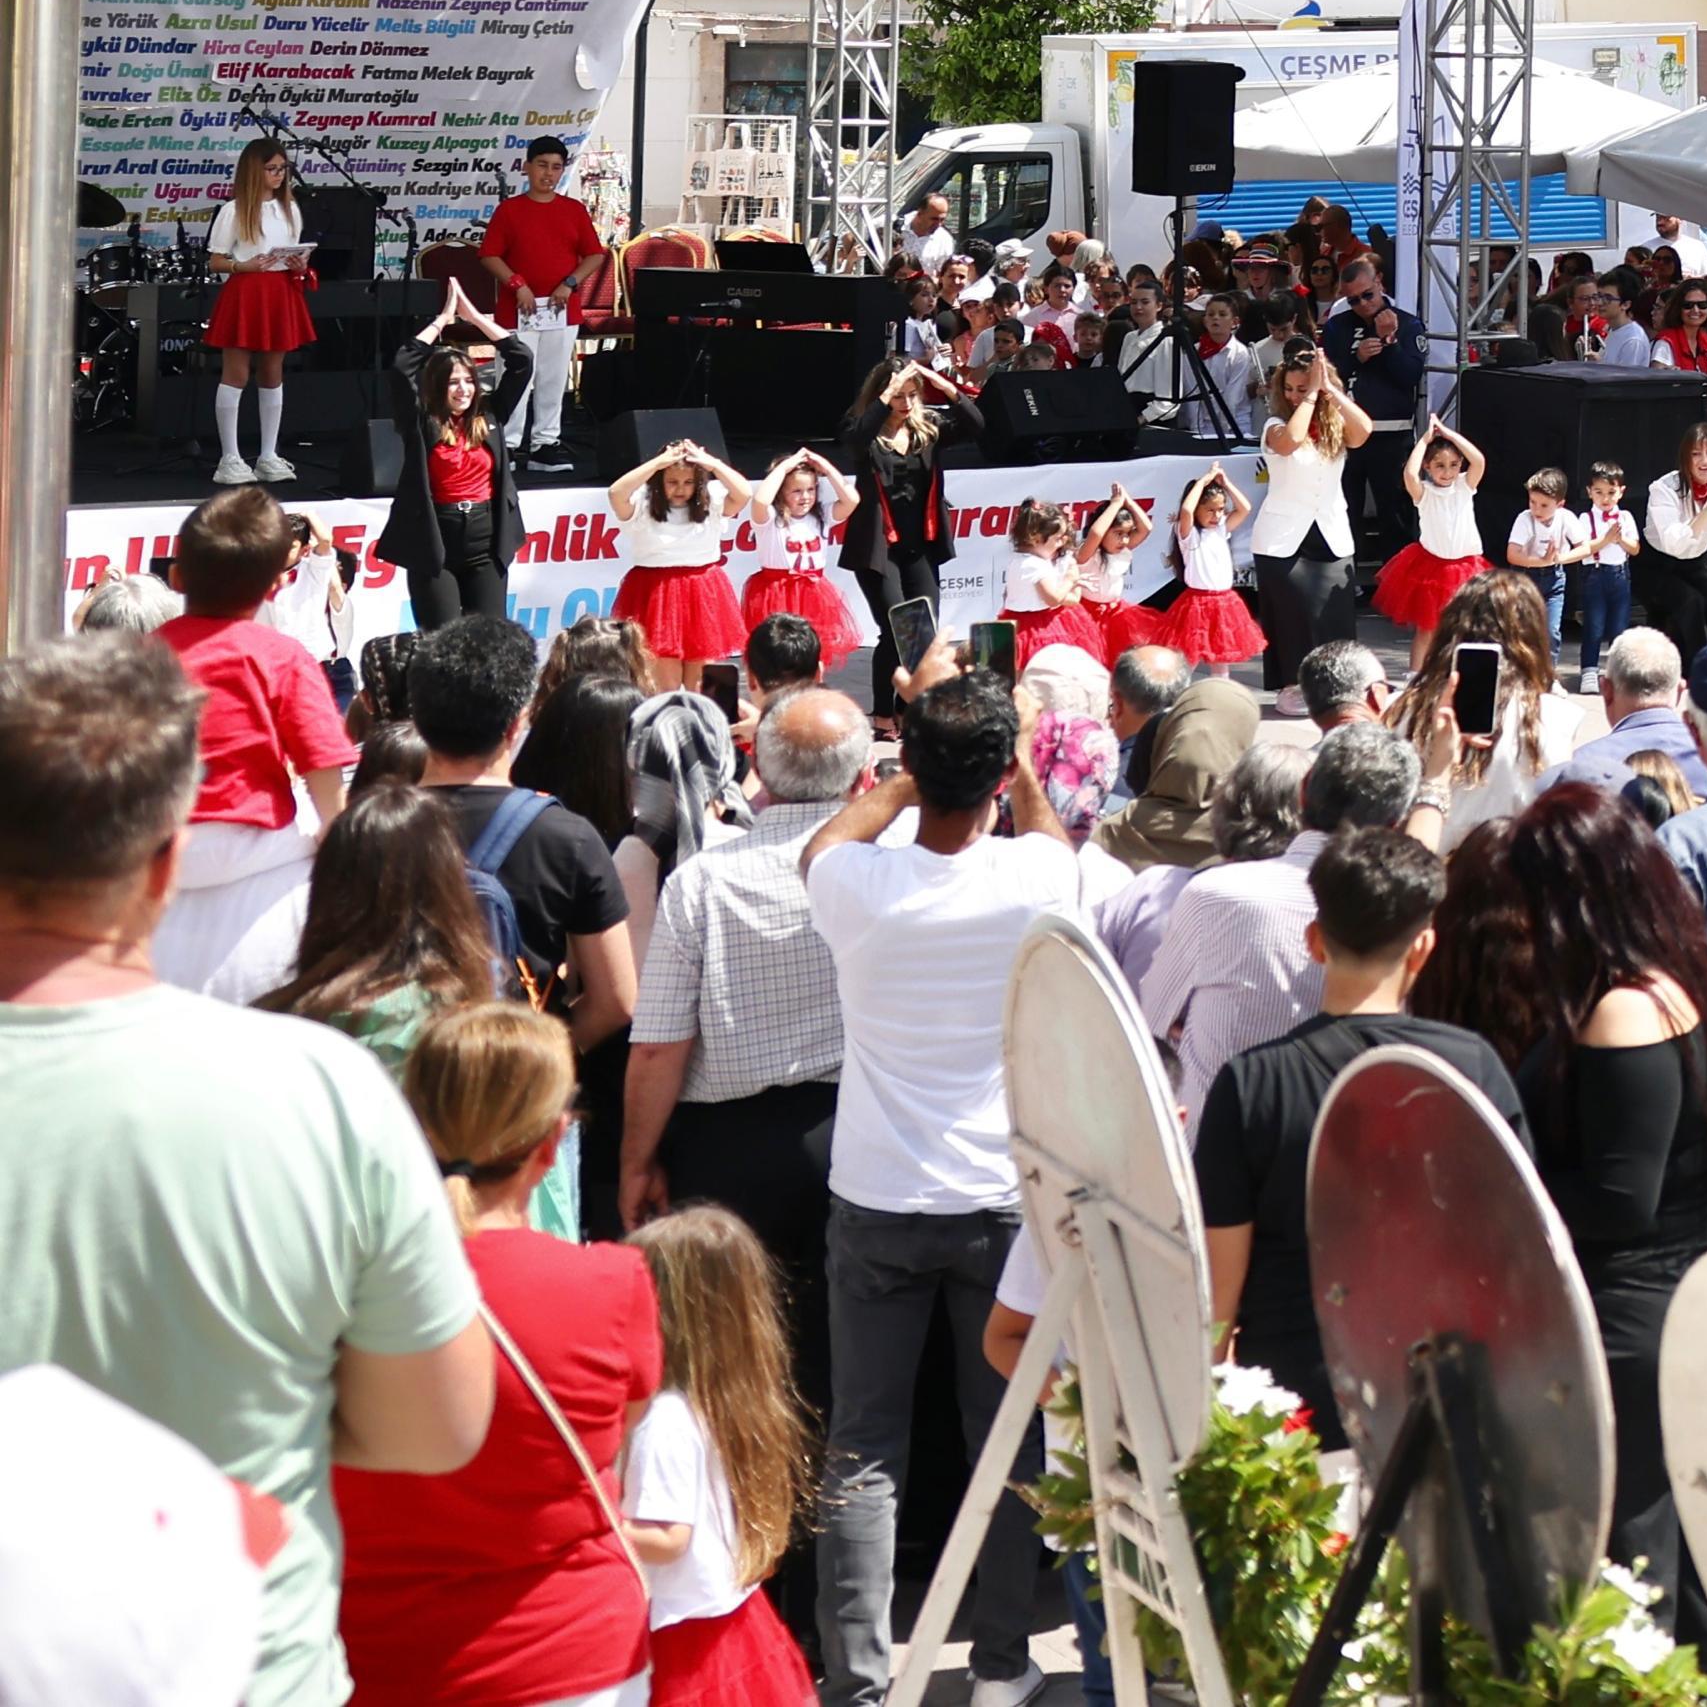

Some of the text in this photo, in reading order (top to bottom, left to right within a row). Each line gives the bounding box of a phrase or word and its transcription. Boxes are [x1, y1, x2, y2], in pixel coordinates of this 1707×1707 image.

[106, 12, 573, 39] Yörük Azra Usul Duru Yücelir Melis Bilgili Miray Çetin
[125, 37, 429, 59] Dündar Hira Ceylan Derin Dönmez
[117, 60, 165, 83] Doğa
[217, 62, 250, 83] Elif
[253, 61, 354, 80] Karabacak
[362, 65, 418, 80] Fatma
[421, 66, 473, 80] Melek
[476, 66, 534, 85] Bayrak
[1280, 53, 1367, 80] ÇEŞME
[157, 86, 196, 104] Eliz
[196, 82, 221, 102] Öz
[279, 83, 324, 107] Öykü
[327, 89, 418, 107] Muratoğlu
[122, 109, 574, 132] Erten Öykü Zeynep Kumral Nehir Ata Doruk
[80, 135, 144, 152] Essade
[150, 134, 193, 153] Mine
[376, 133, 430, 154] Kuzey
[433, 136, 499, 153] Alpagot
[113, 158, 157, 174] Aral
[161, 158, 234, 181] Gününç
[412, 155, 469, 176] Sezgin
[154, 183, 203, 204] Uğur
[404, 179, 472, 200] Kadriye
[415, 202, 480, 225] Belinay
